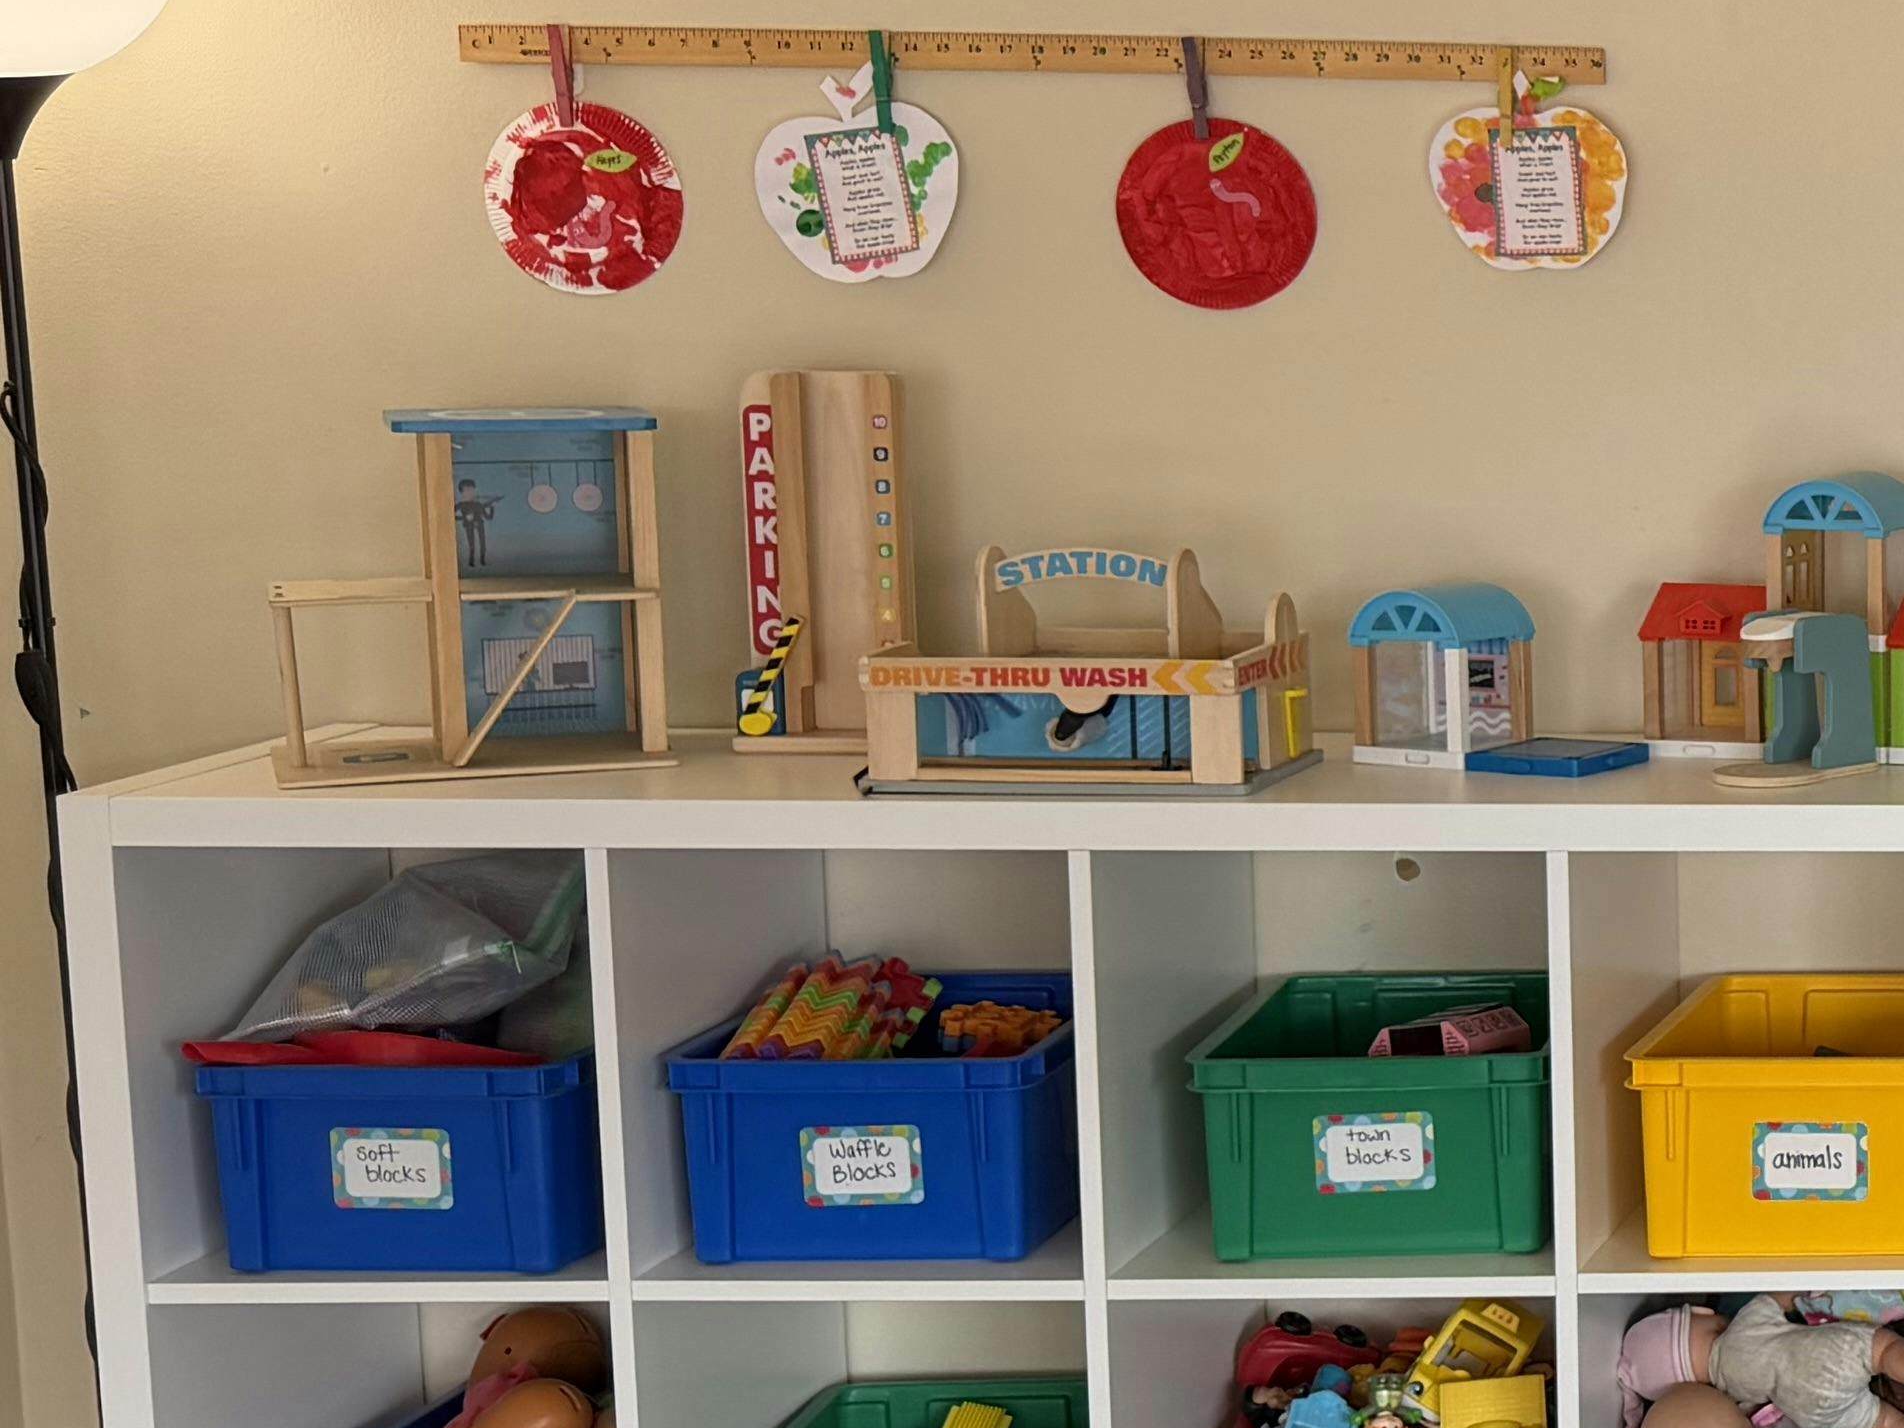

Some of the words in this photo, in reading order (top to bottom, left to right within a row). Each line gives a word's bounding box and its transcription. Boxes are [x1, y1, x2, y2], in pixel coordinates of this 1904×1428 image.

[748, 412, 782, 649] PARKING
[997, 551, 1167, 588] STATION
[871, 667, 1051, 687] DRIVE-THRU
[1058, 667, 1147, 687] WASH
[1238, 659, 1267, 686] ENTER
[1345, 1127, 1390, 1145] town
[828, 1140, 892, 1160] Waffle
[1771, 1146, 1843, 1172] animals
[364, 1164, 427, 1183] blocks
